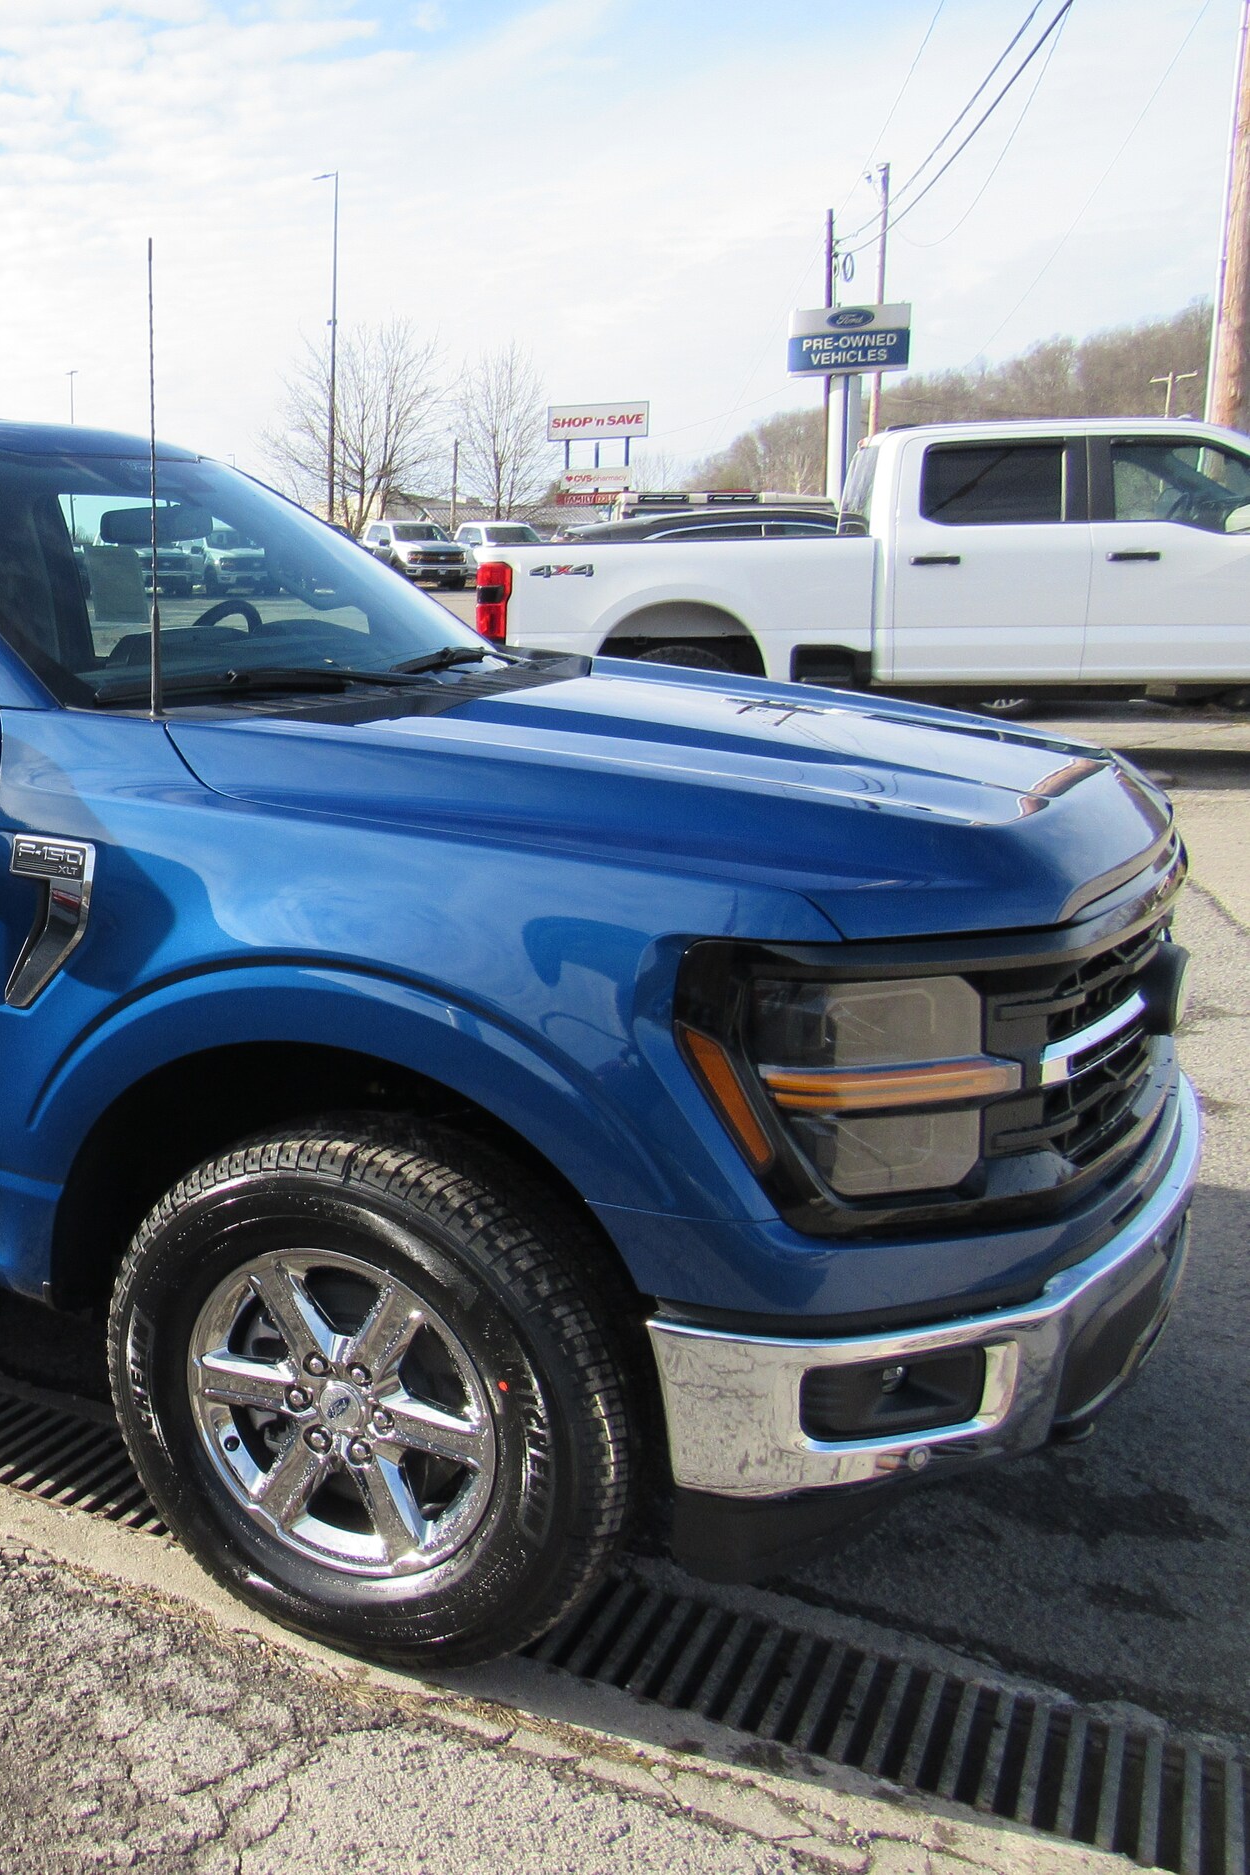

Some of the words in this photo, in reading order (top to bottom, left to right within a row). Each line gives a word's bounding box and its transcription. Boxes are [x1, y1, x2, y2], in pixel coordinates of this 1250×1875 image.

[802, 333, 897, 352] PRE-OWNED
[810, 349, 887, 366] VEHICLES
[551, 416, 593, 429] SHOP
[606, 413, 645, 426] SAVE
[573, 474, 593, 483] CVS
[593, 475, 627, 484] pharmacy
[564, 494, 595, 506] FAMILY
[17, 842, 84, 867] F-150
[58, 865, 79, 876] XLT
